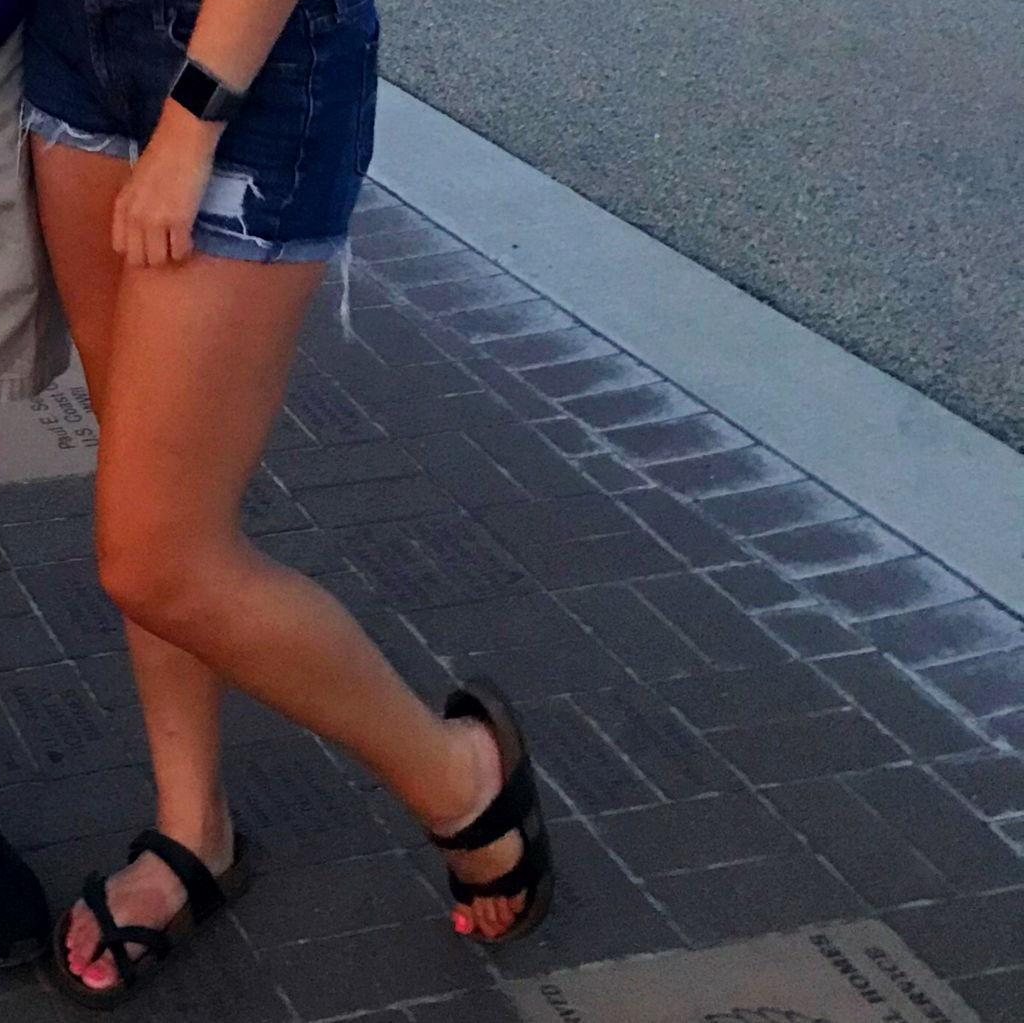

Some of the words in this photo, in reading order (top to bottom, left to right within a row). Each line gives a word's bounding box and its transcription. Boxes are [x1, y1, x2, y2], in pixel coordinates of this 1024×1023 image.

[51, 392, 82, 423] Coast
[48, 427, 76, 449] Paul
[809, 933, 885, 1004] HOMES
